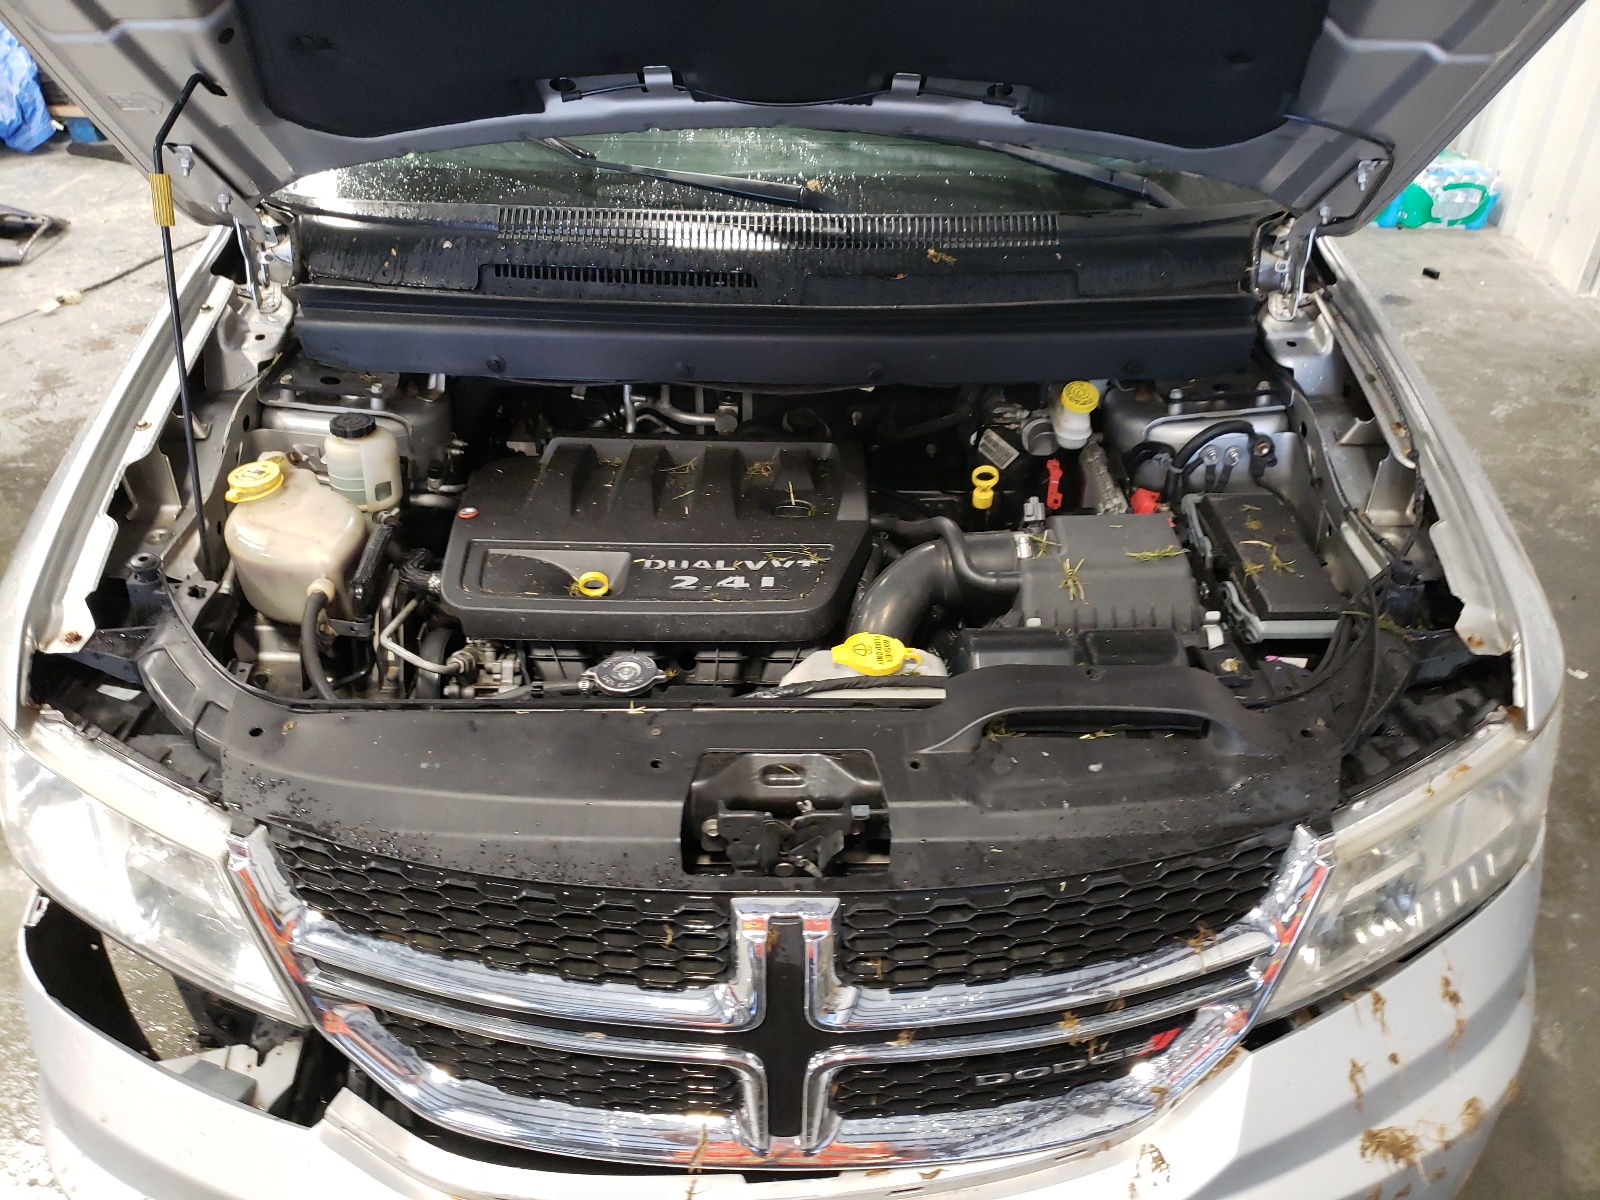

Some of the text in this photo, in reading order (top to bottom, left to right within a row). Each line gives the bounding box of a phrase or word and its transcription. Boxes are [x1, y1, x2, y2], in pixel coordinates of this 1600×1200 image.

[643, 559, 818, 572] DUAL VVT
[873, 635, 885, 665] FLUID ONLY
[883, 639, 894, 662] WASHER
[975, 1042, 1152, 1086] DODGE
